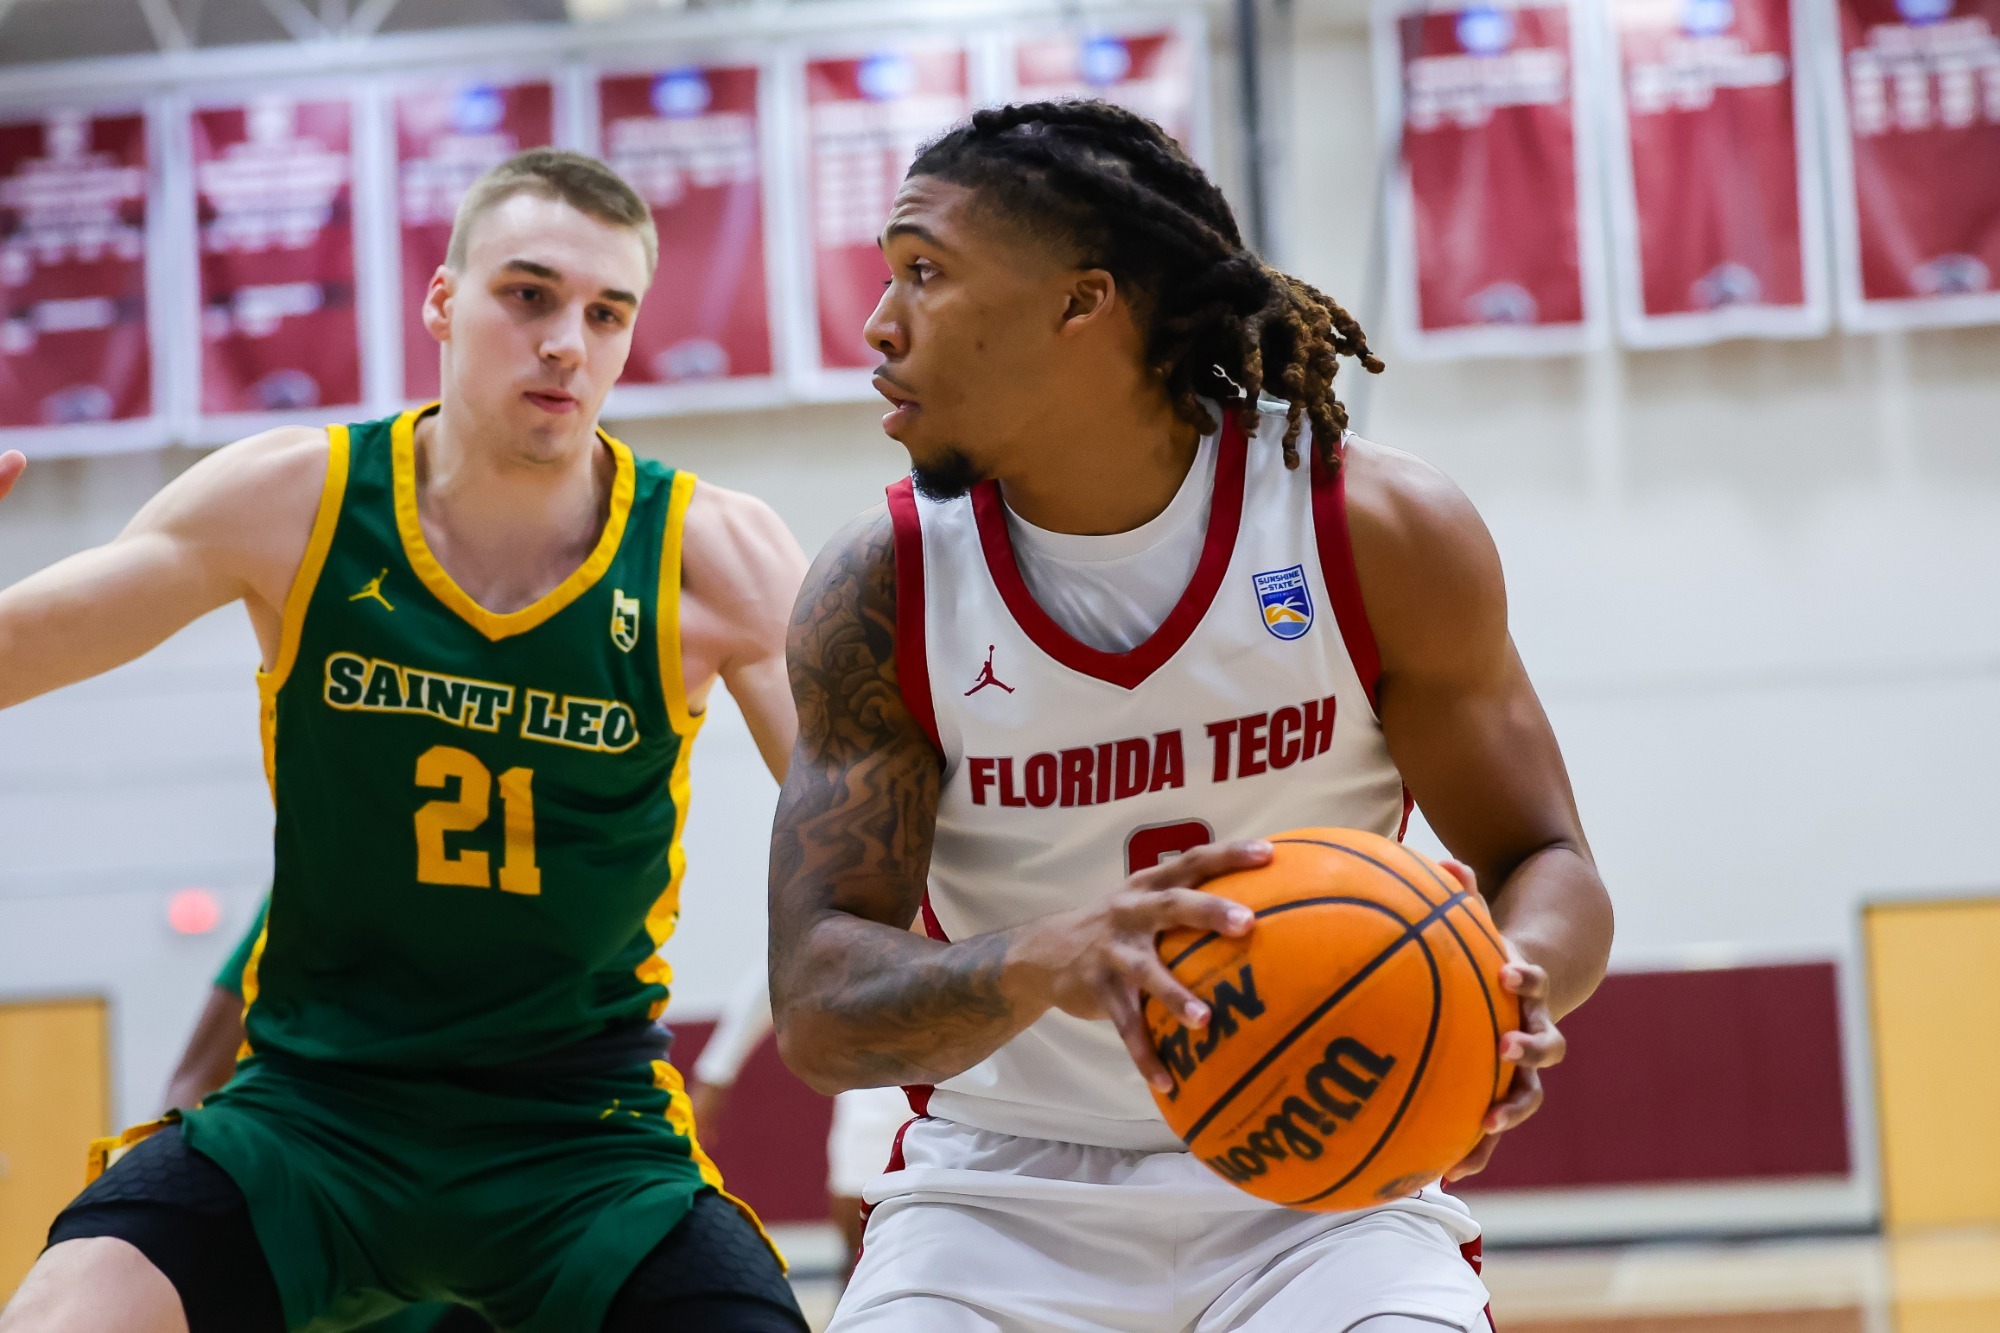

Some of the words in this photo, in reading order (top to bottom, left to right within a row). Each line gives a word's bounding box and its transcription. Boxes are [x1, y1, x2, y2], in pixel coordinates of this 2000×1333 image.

[1257, 570, 1300, 585] SUNSHINE
[1268, 581, 1293, 591] STATE
[324, 652, 515, 732] SAINT
[521, 688, 640, 754] LEO
[967, 728, 1185, 809] FLORIDA
[1204, 693, 1337, 784] TECH
[414, 745, 541, 896] 21
[1204, 1036, 1397, 1184] Wilson
